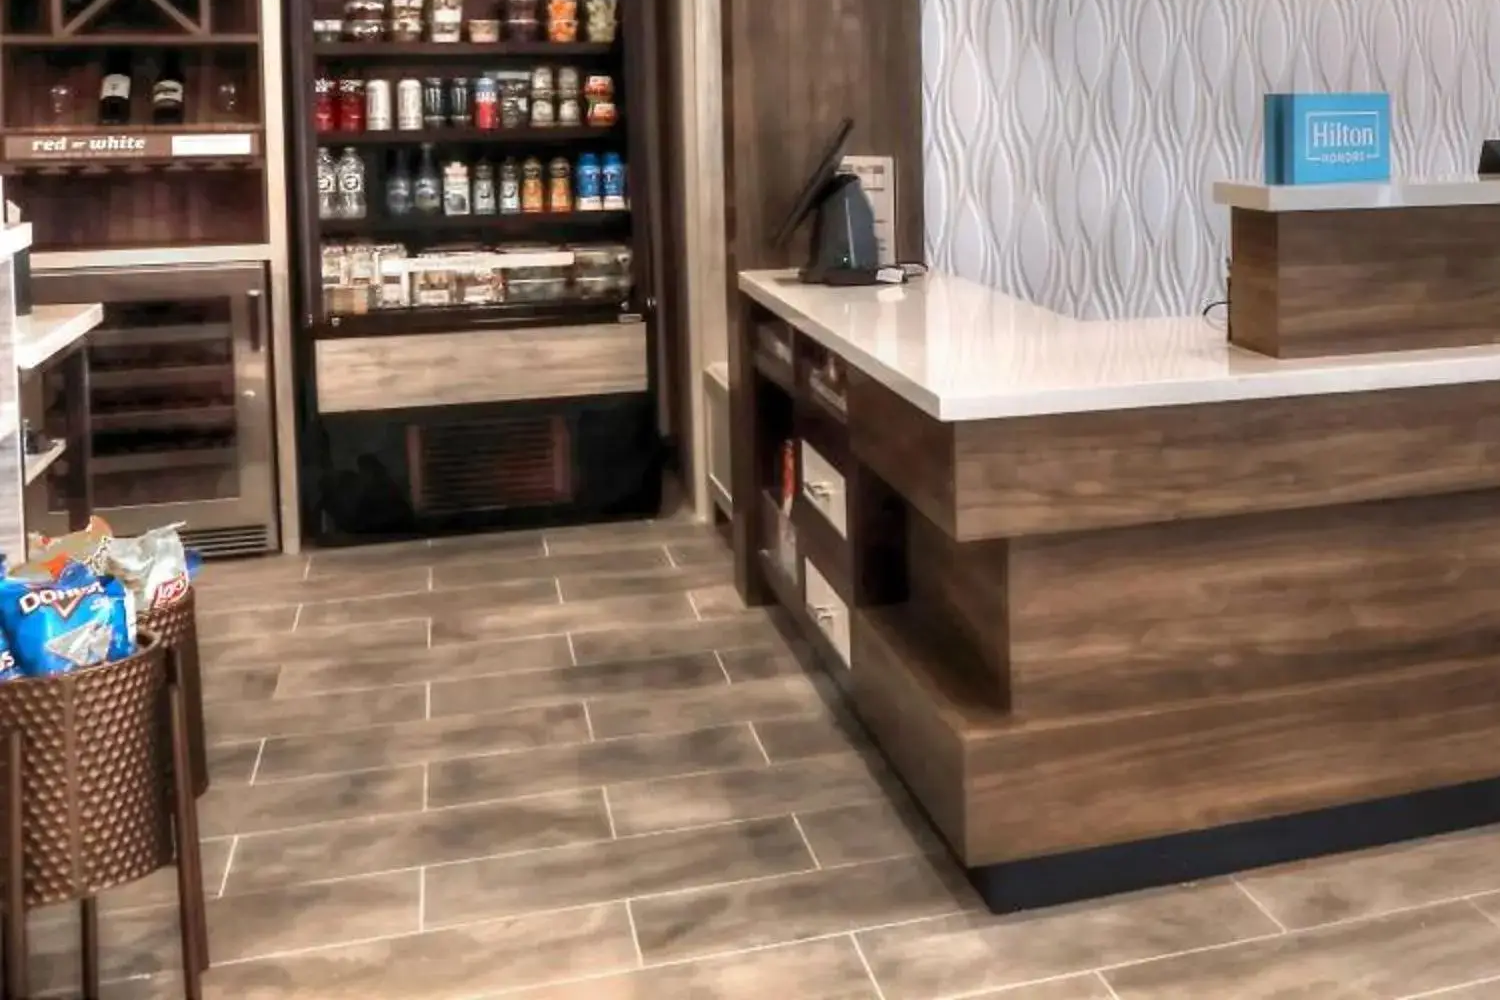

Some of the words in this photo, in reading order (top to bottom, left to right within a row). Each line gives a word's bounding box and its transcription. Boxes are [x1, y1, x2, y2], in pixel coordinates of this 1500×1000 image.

[31, 136, 68, 151] red
[89, 135, 146, 150] white
[1312, 121, 1374, 149] Hilton
